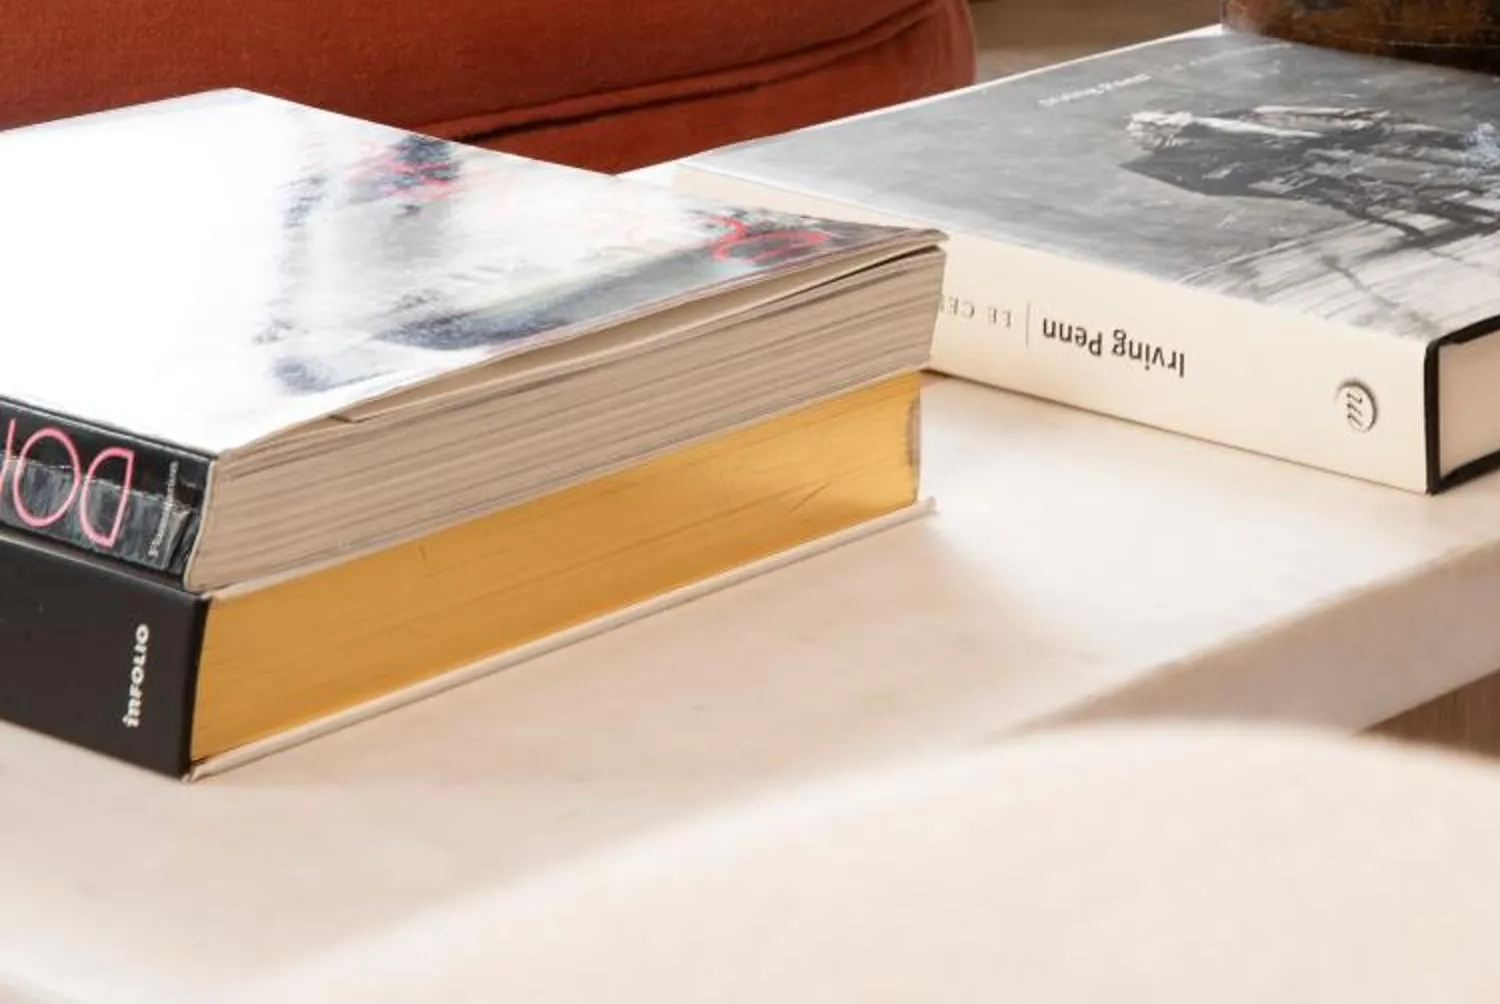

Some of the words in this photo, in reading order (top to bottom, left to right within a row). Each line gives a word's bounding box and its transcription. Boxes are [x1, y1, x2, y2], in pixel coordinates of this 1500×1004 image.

[940, 295, 976, 321] CE
[987, 306, 1012, 329] LE
[1042, 317, 1103, 357] Penn
[1112, 328, 1185, 378] Irving
